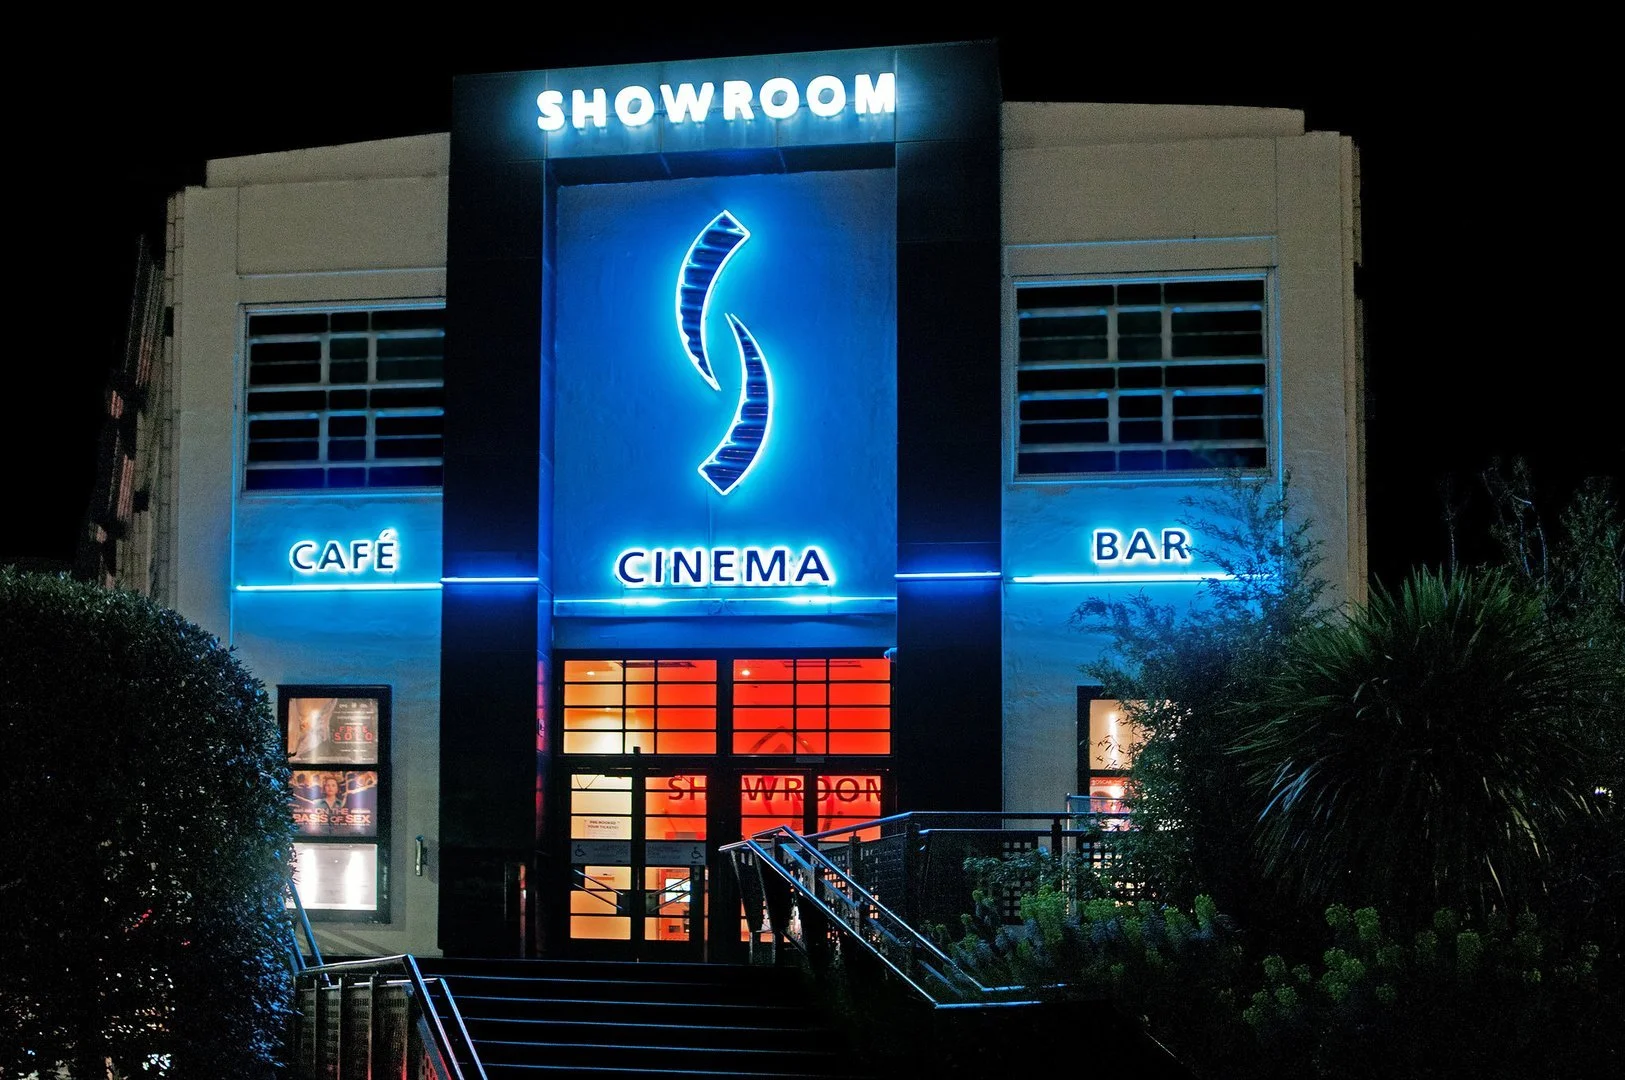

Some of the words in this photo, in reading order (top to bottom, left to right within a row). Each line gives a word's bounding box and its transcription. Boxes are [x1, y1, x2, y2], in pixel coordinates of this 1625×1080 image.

[536, 72, 896, 131] SHOWROOM
[291, 531, 395, 570] CAFÉ
[1095, 529, 1189, 562] BAR
[617, 548, 831, 584] CINEMA
[334, 732, 373, 741] SOLO
[332, 807, 349, 815] THE
[345, 814, 371, 823] SEX
